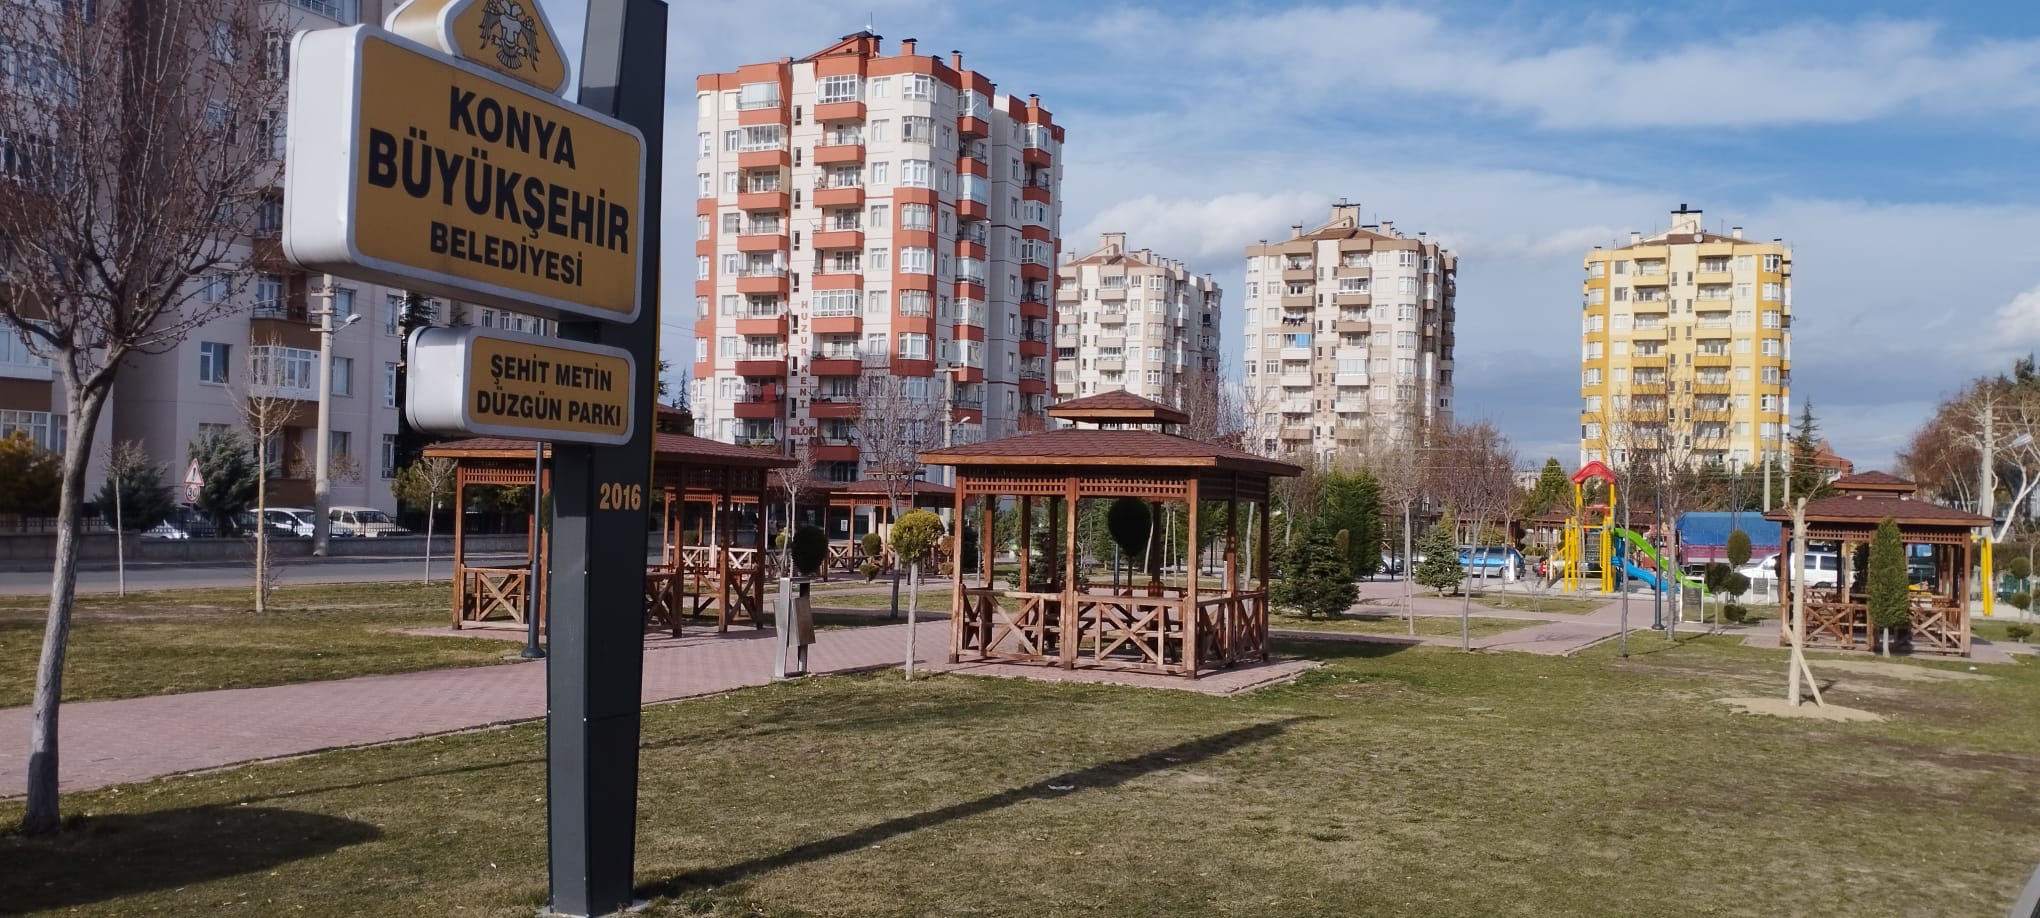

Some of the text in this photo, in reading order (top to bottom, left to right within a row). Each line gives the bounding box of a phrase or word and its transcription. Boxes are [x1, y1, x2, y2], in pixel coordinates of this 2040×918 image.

[449, 86, 576, 170] KONYA
[368, 126, 629, 254] BÜYÜKŞEHİR
[430, 221, 583, 287] BELEDİYESİ
[491, 354, 612, 392] ŞEHİT METİN
[477, 386, 621, 426] DÜZGÜN PARKI
[790, 426, 817, 436] BLOK
[600, 482, 641, 511] 2016
